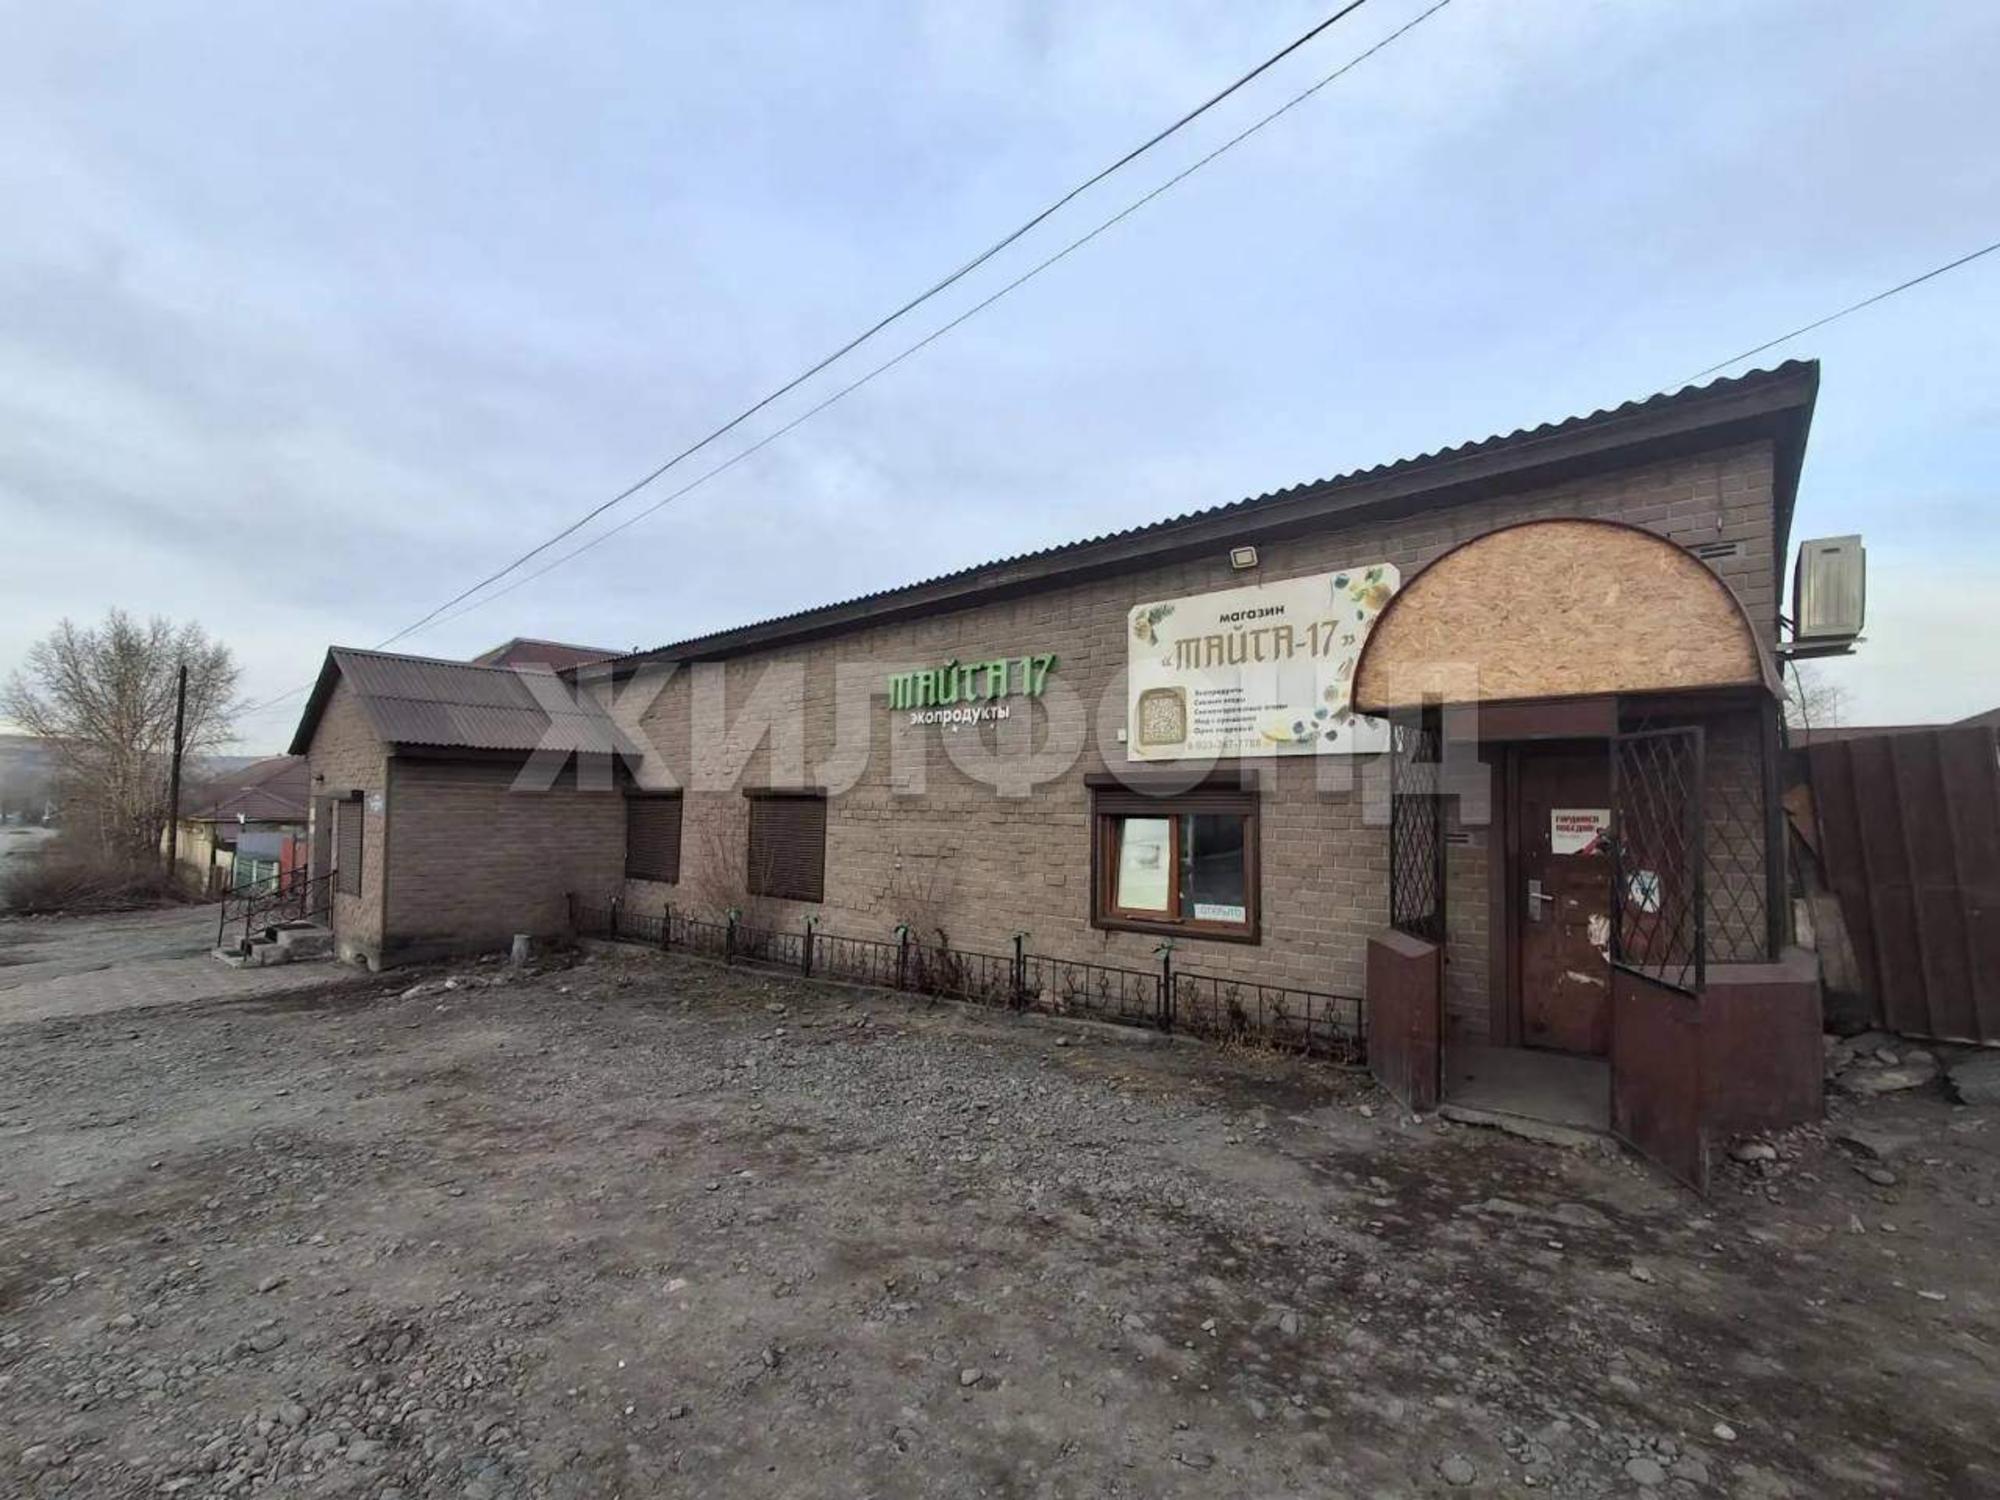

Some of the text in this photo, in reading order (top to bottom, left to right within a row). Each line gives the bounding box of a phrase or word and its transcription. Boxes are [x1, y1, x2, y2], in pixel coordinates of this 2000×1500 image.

[1219, 605, 1285, 623] магазин
[1021, 652, 1058, 698] 17
[909, 705, 1010, 726] экопродукты
